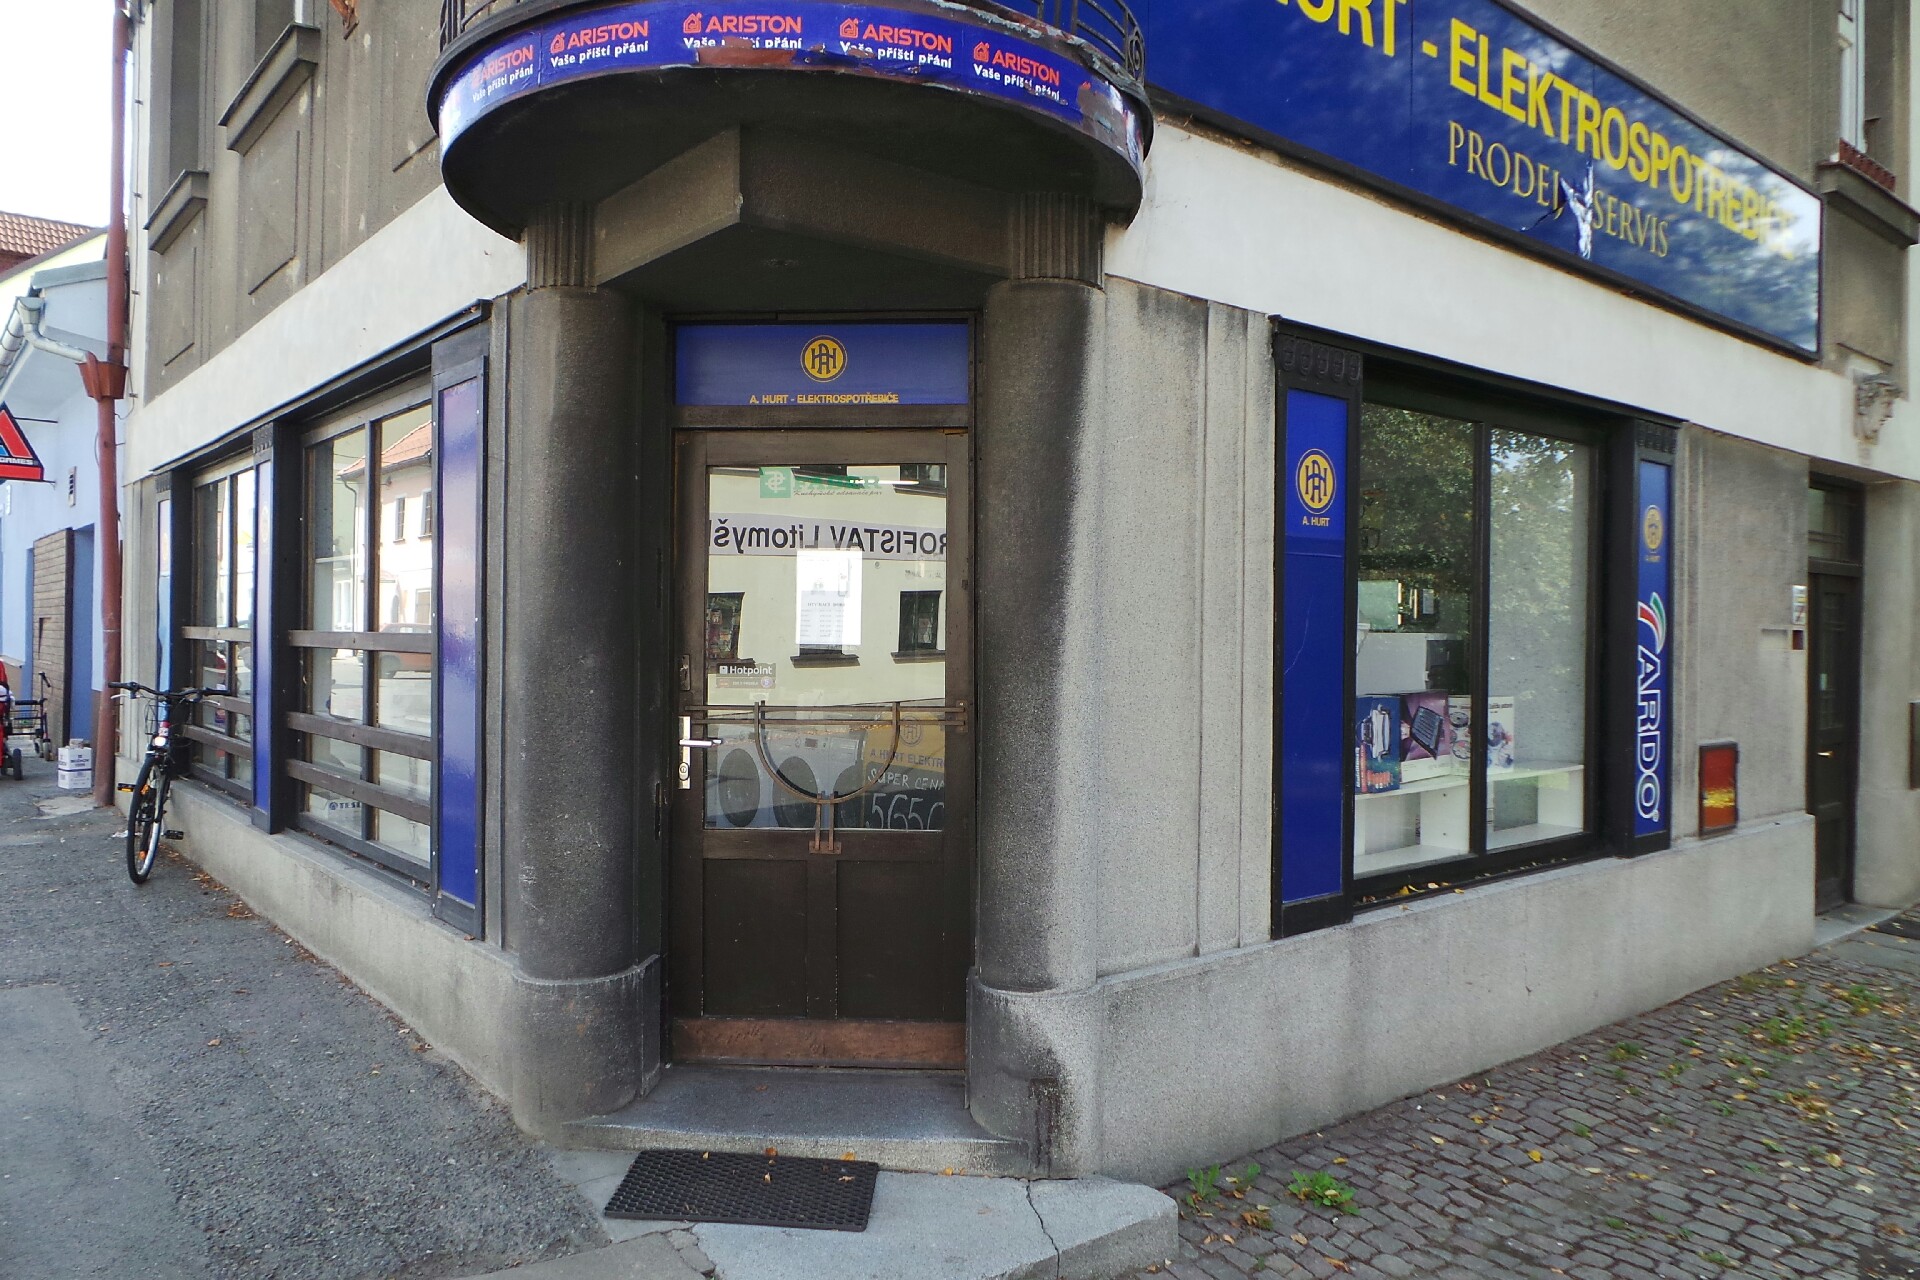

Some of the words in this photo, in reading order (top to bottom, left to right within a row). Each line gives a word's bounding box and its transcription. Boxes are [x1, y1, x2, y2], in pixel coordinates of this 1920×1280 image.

[566, 20, 649, 50] ARISTON
[705, 15, 802, 34] ARISTON
[862, 24, 953, 54] ARISTON
[550, 53, 576, 69] Vaše
[579, 44, 611, 64] příští
[614, 40, 649, 58] přání
[683, 37, 716, 49] Vaše
[877, 42, 914, 60] příští
[918, 53, 952, 69] přání
[480, 44, 534, 84] ARISTON
[973, 63, 1001, 80] Vaše
[991, 49, 1060, 87] ARISTON
[487, 73, 508, 96] příští
[509, 63, 534, 85] přání
[1448, 120, 1565, 220] PRODEJ
[1592, 189, 1670, 258] SERVIS
[750, 395, 760, 404] A.
[762, 395, 788, 404] HURT
[797, 391, 899, 404] ELEKTROSPOTŘEBIČE
[1311, 516, 1330, 527] HURT
[729, 665, 773, 677] Hotpoint
[1637, 644, 1661, 819] ARDO
